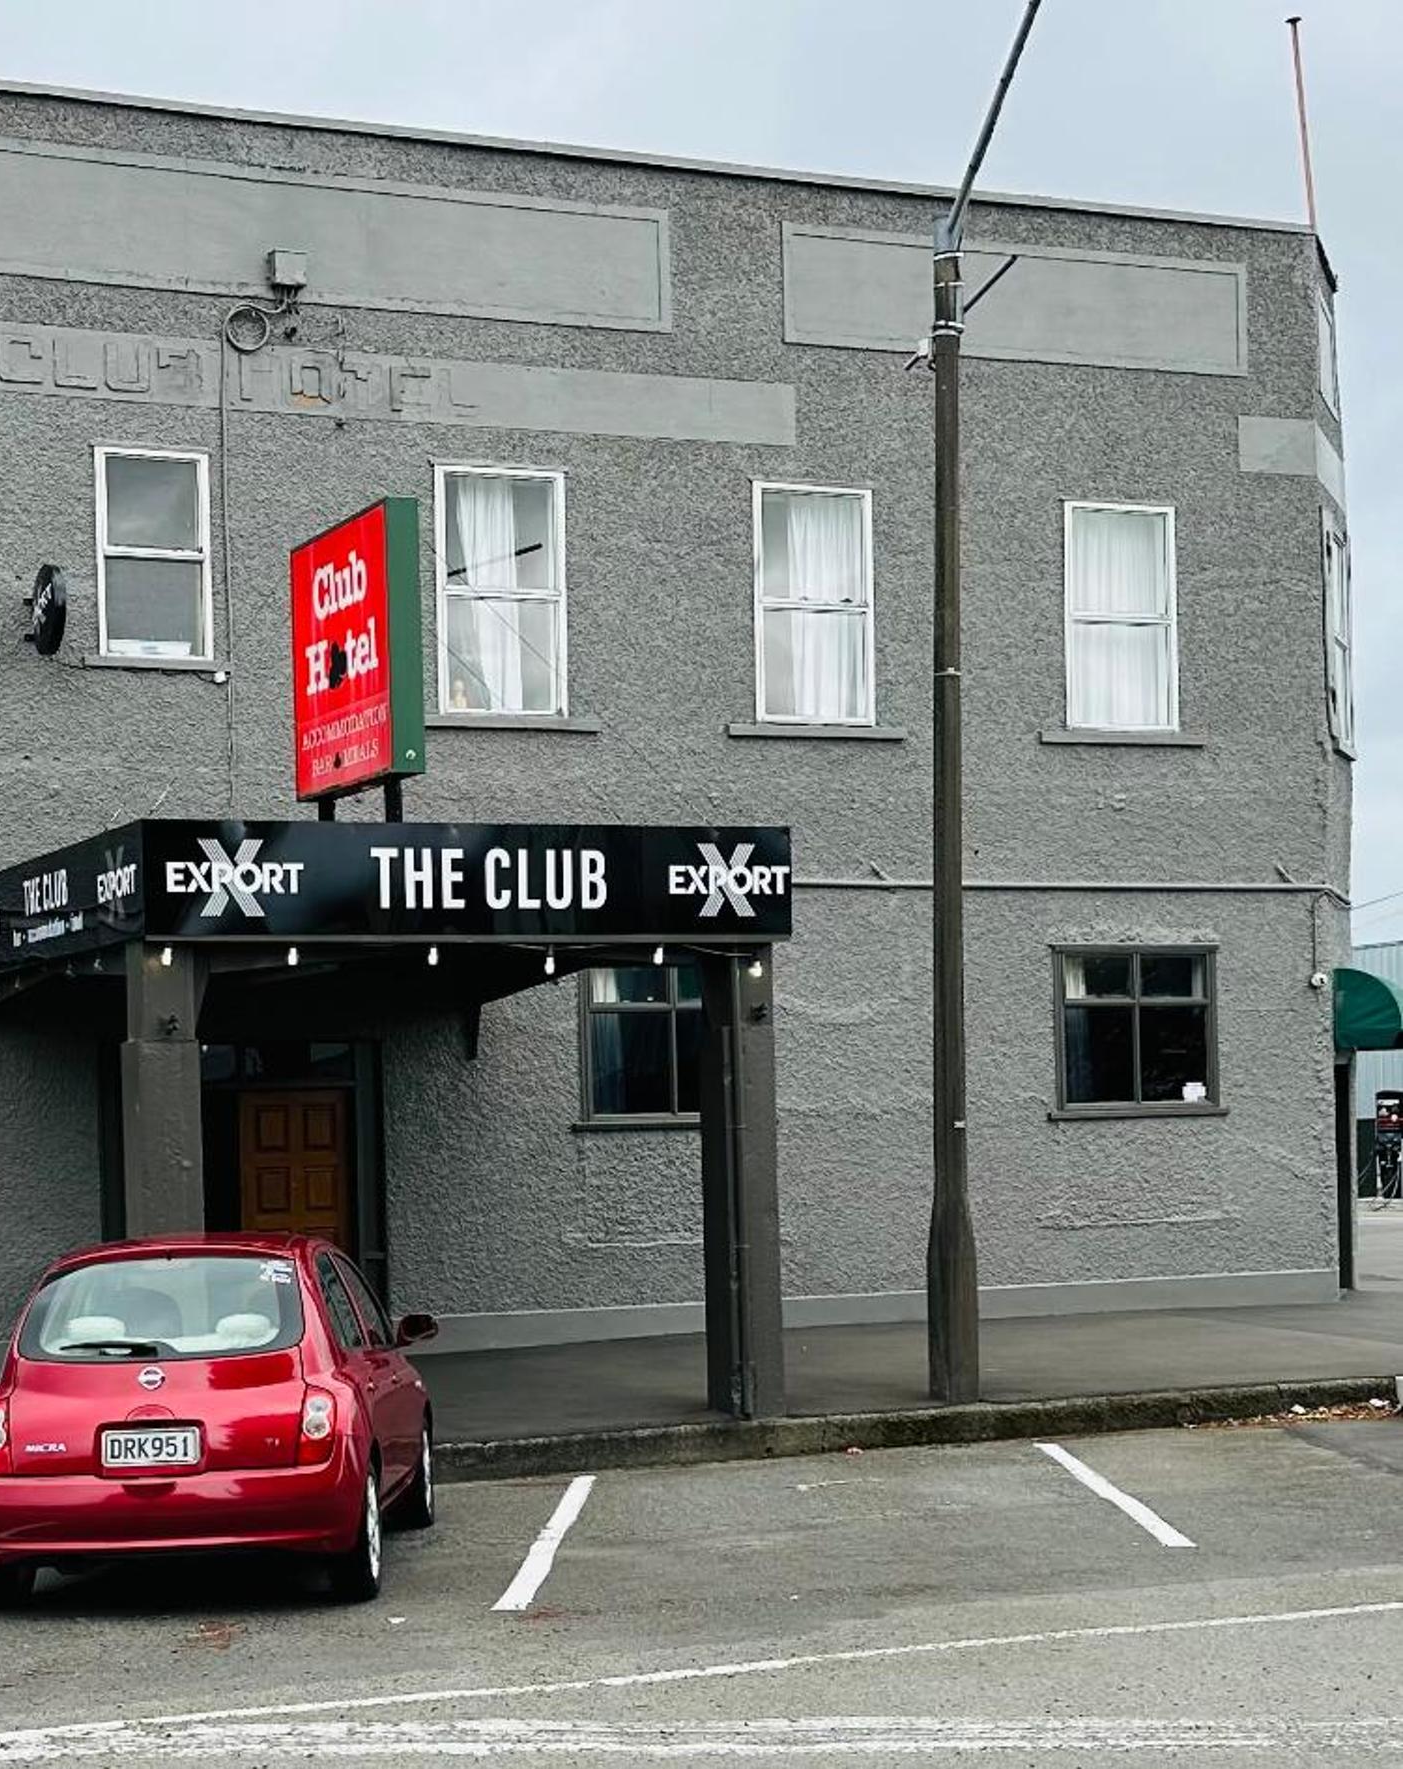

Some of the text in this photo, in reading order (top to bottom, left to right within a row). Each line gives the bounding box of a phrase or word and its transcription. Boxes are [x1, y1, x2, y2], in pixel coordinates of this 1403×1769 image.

[312, 550, 368, 621] Club
[305, 616, 380, 696] Htel
[22, 868, 69, 917] THE CLUB
[97, 863, 137, 904] EXPORT
[165, 861, 304, 894] EXPORT
[370, 846, 608, 910] THE CLUB
[668, 864, 791, 896] EXPORT
[109, 1436, 189, 1460] DRK951
